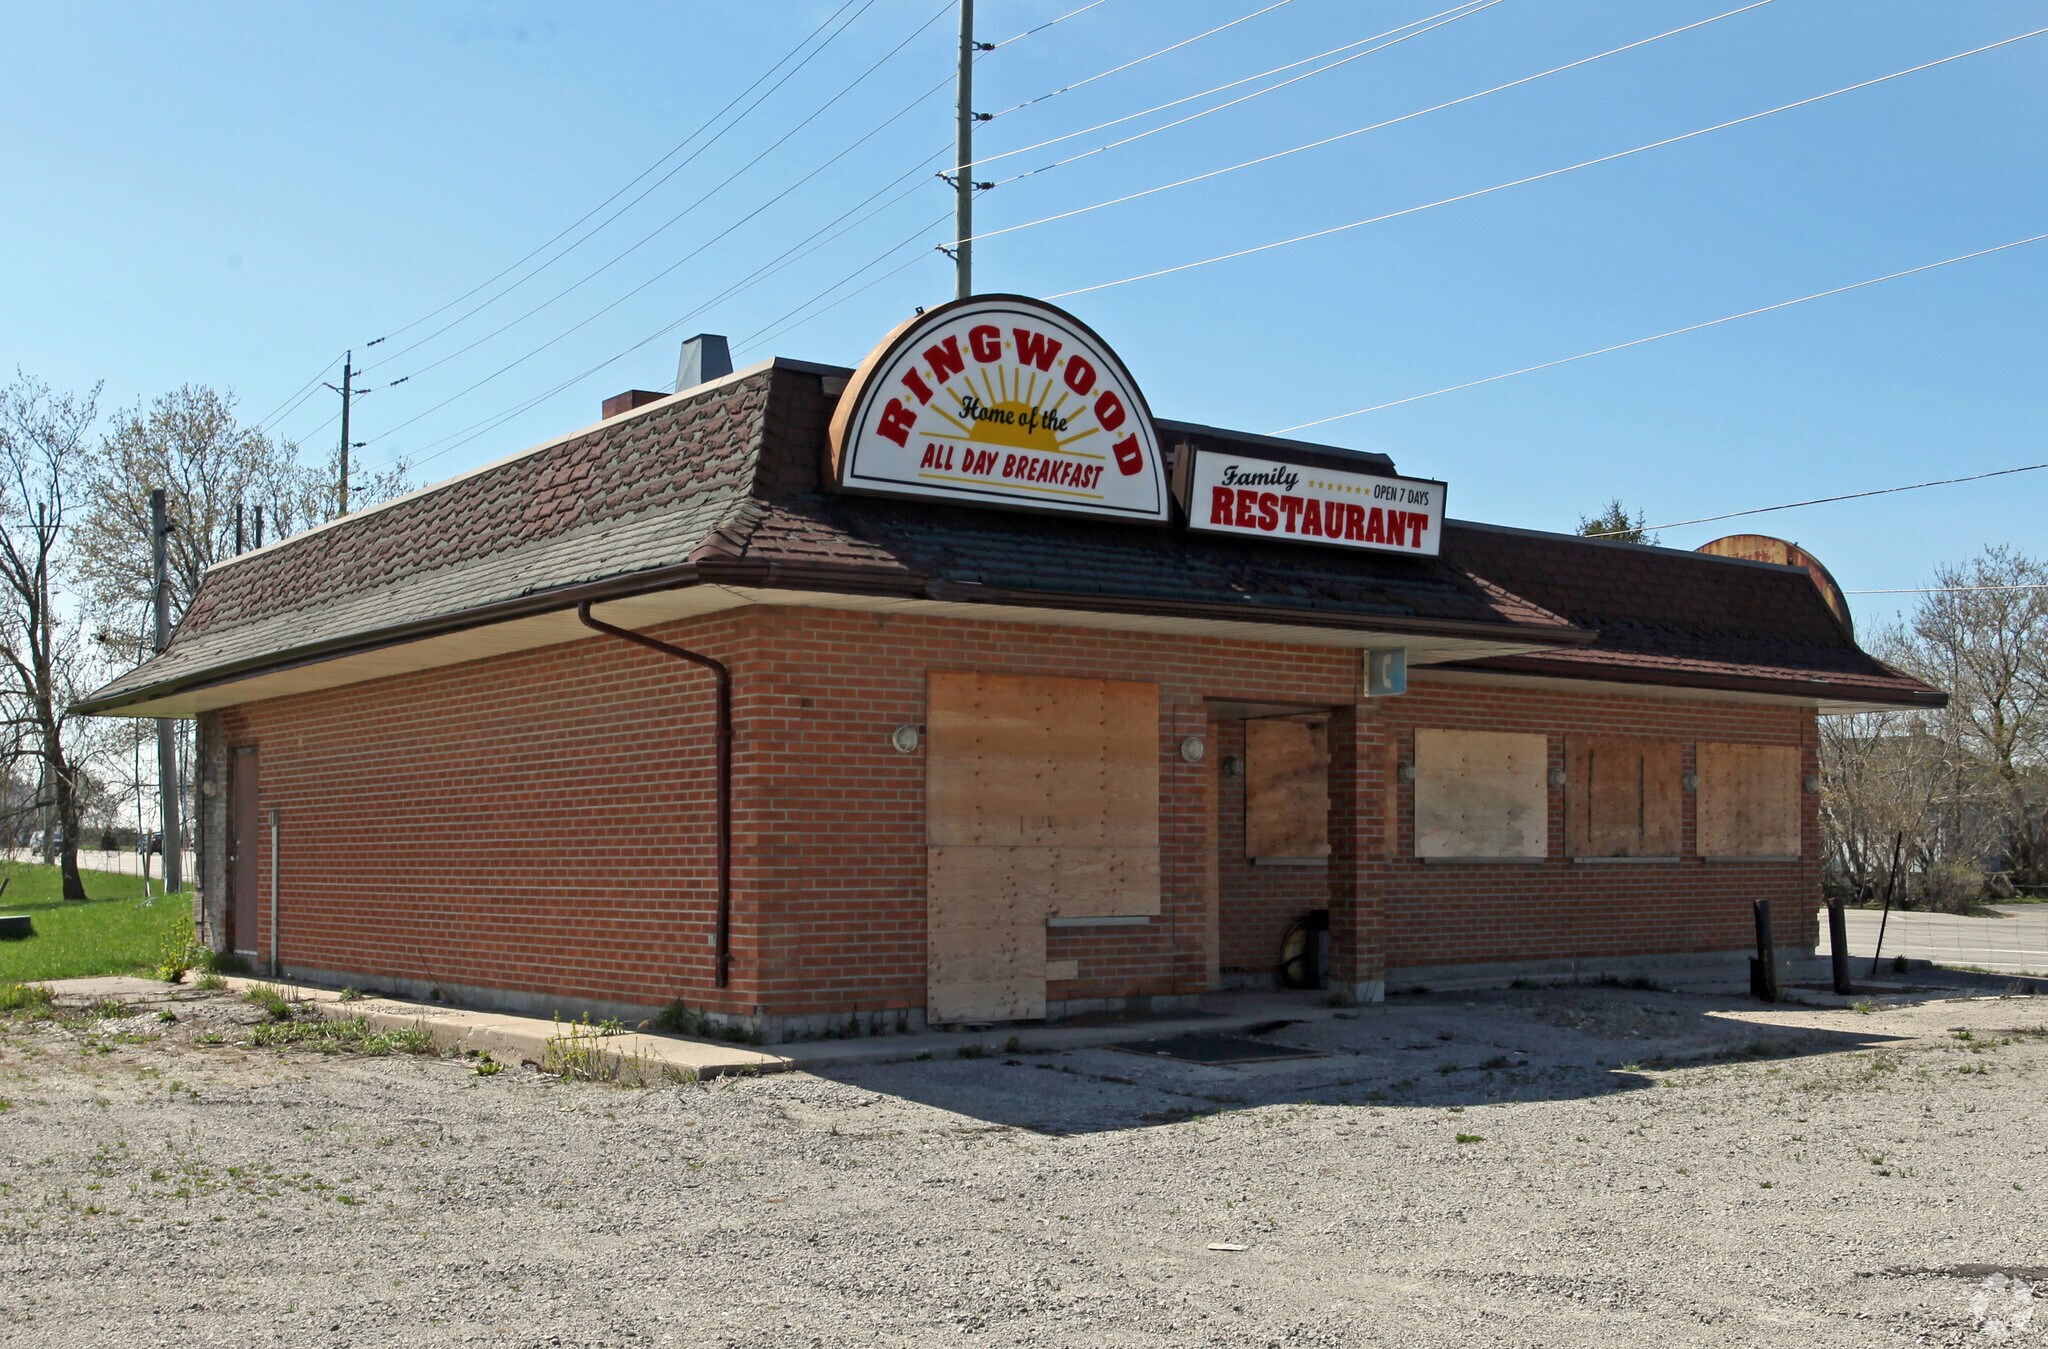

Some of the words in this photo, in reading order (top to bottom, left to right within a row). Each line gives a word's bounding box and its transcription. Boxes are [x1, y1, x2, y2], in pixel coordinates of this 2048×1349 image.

[877, 325, 1143, 476] RINGWOOD
[959, 395, 1014, 426] Home
[1018, 405, 1038, 434] of
[1042, 408, 1068, 432] the
[920, 443, 953, 470] ALL
[961, 448, 999, 476] DAY
[1002, 453, 1104, 489] BREAKFAST
[1221, 465, 1299, 491] Family
[1373, 484, 1396, 502] OPEN
[1399, 488, 1406, 503] 7
[1408, 489, 1429, 506] DAYS
[1210, 486, 1428, 548] RESTAURANT
